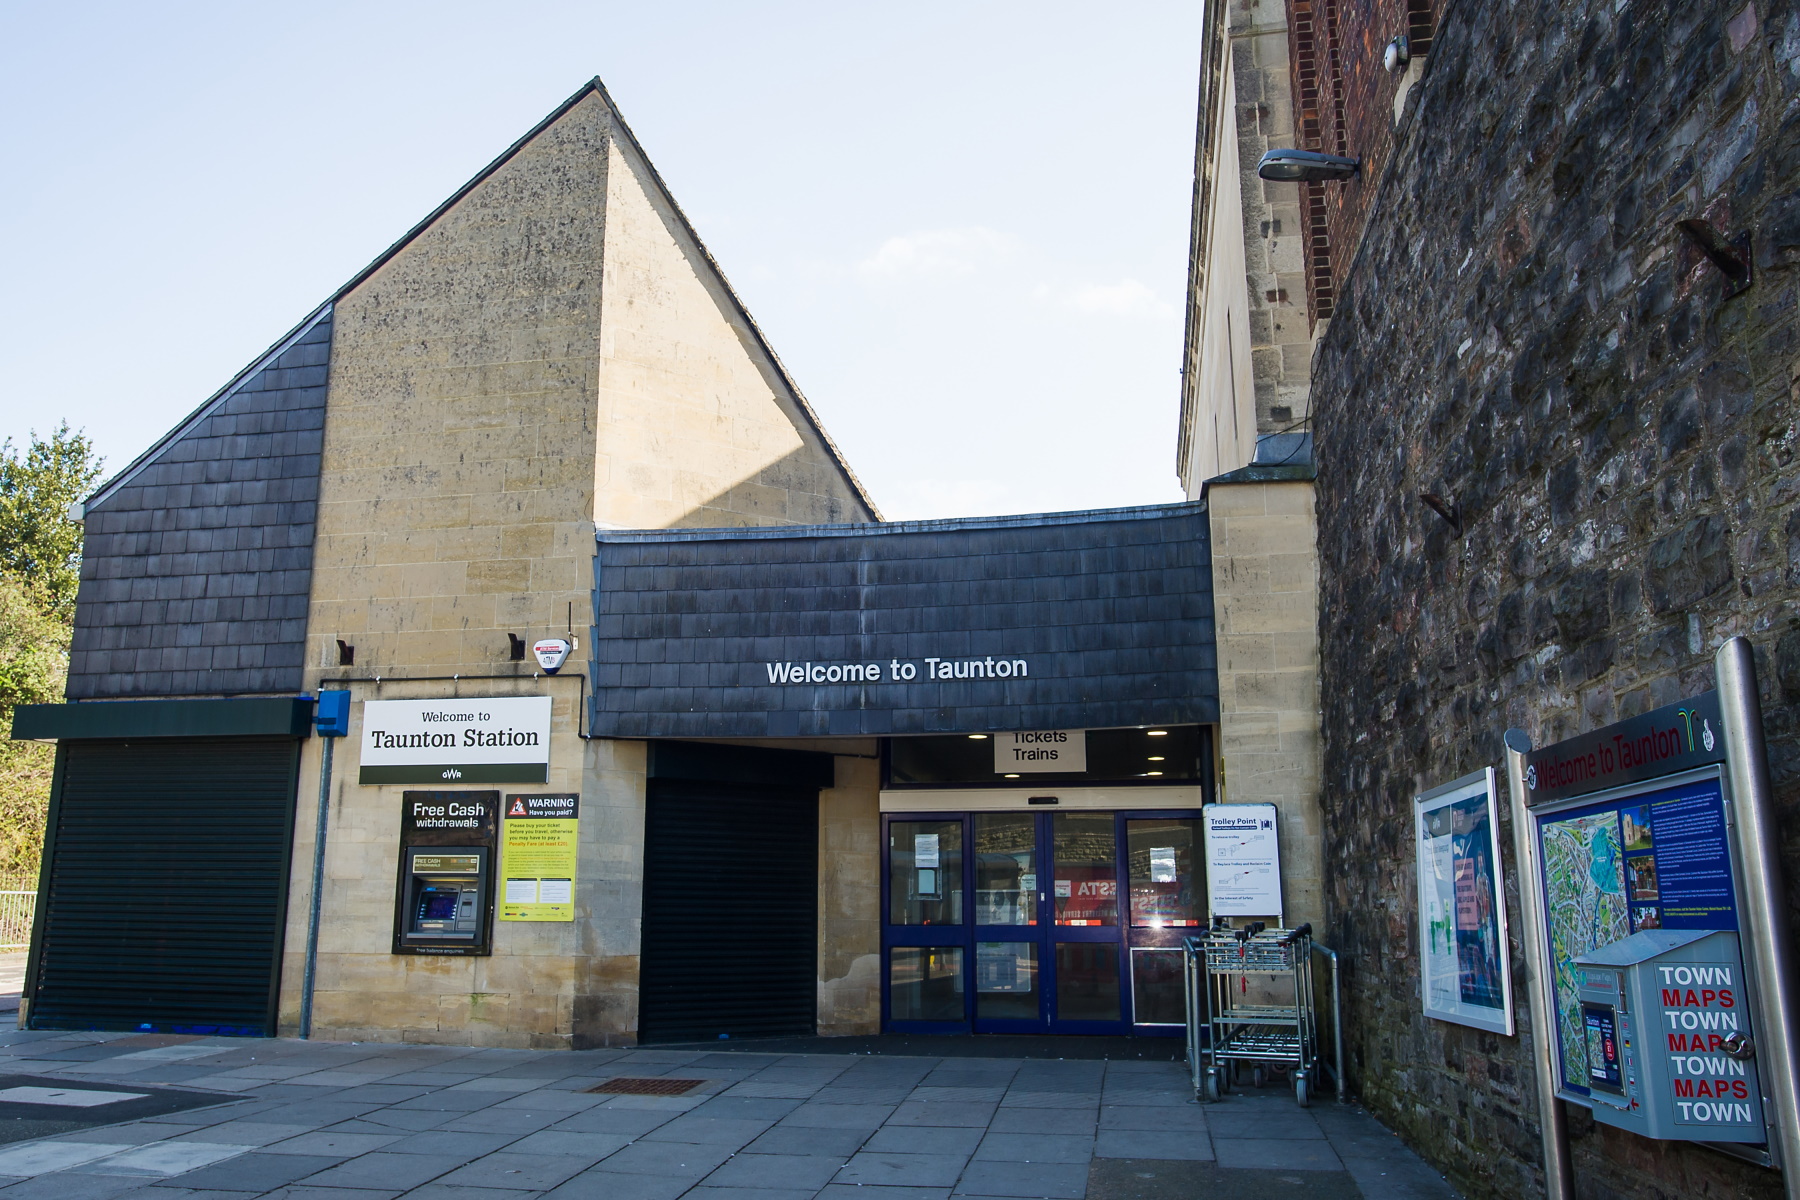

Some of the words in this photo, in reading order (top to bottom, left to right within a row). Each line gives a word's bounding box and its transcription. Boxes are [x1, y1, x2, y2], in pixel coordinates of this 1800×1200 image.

[766, 661, 880, 684] Welcome
[890, 659, 916, 681] to
[924, 656, 1028, 680] Taunton
[422, 712, 474, 722] Welcome
[478, 711, 491, 722] to
[372, 730, 456, 749] Taunton
[463, 728, 539, 747] Station
[1013, 731, 1067, 743] Tickets
[1013, 748, 1058, 760] Trains
[1535, 753, 1596, 792] Welcome
[1599, 743, 1614, 775] to
[1613, 726, 1682, 771] Taunton
[442, 768, 462, 780] GWR
[413, 802, 445, 816] Free
[449, 802, 485, 816] Cash
[528, 798, 574, 808] WARNING
[416, 818, 479, 828] withdrawals
[1659, 967, 1731, 985] TOWN
[1662, 989, 1734, 1008] MAPS
[1665, 1011, 1737, 1030] TOWN
[1668, 1033, 1724, 1053] MAP
[1671, 1056, 1745, 1076] TOWN
[1674, 1079, 1748, 1099] MAPS
[1677, 1102, 1752, 1122] TOWN
